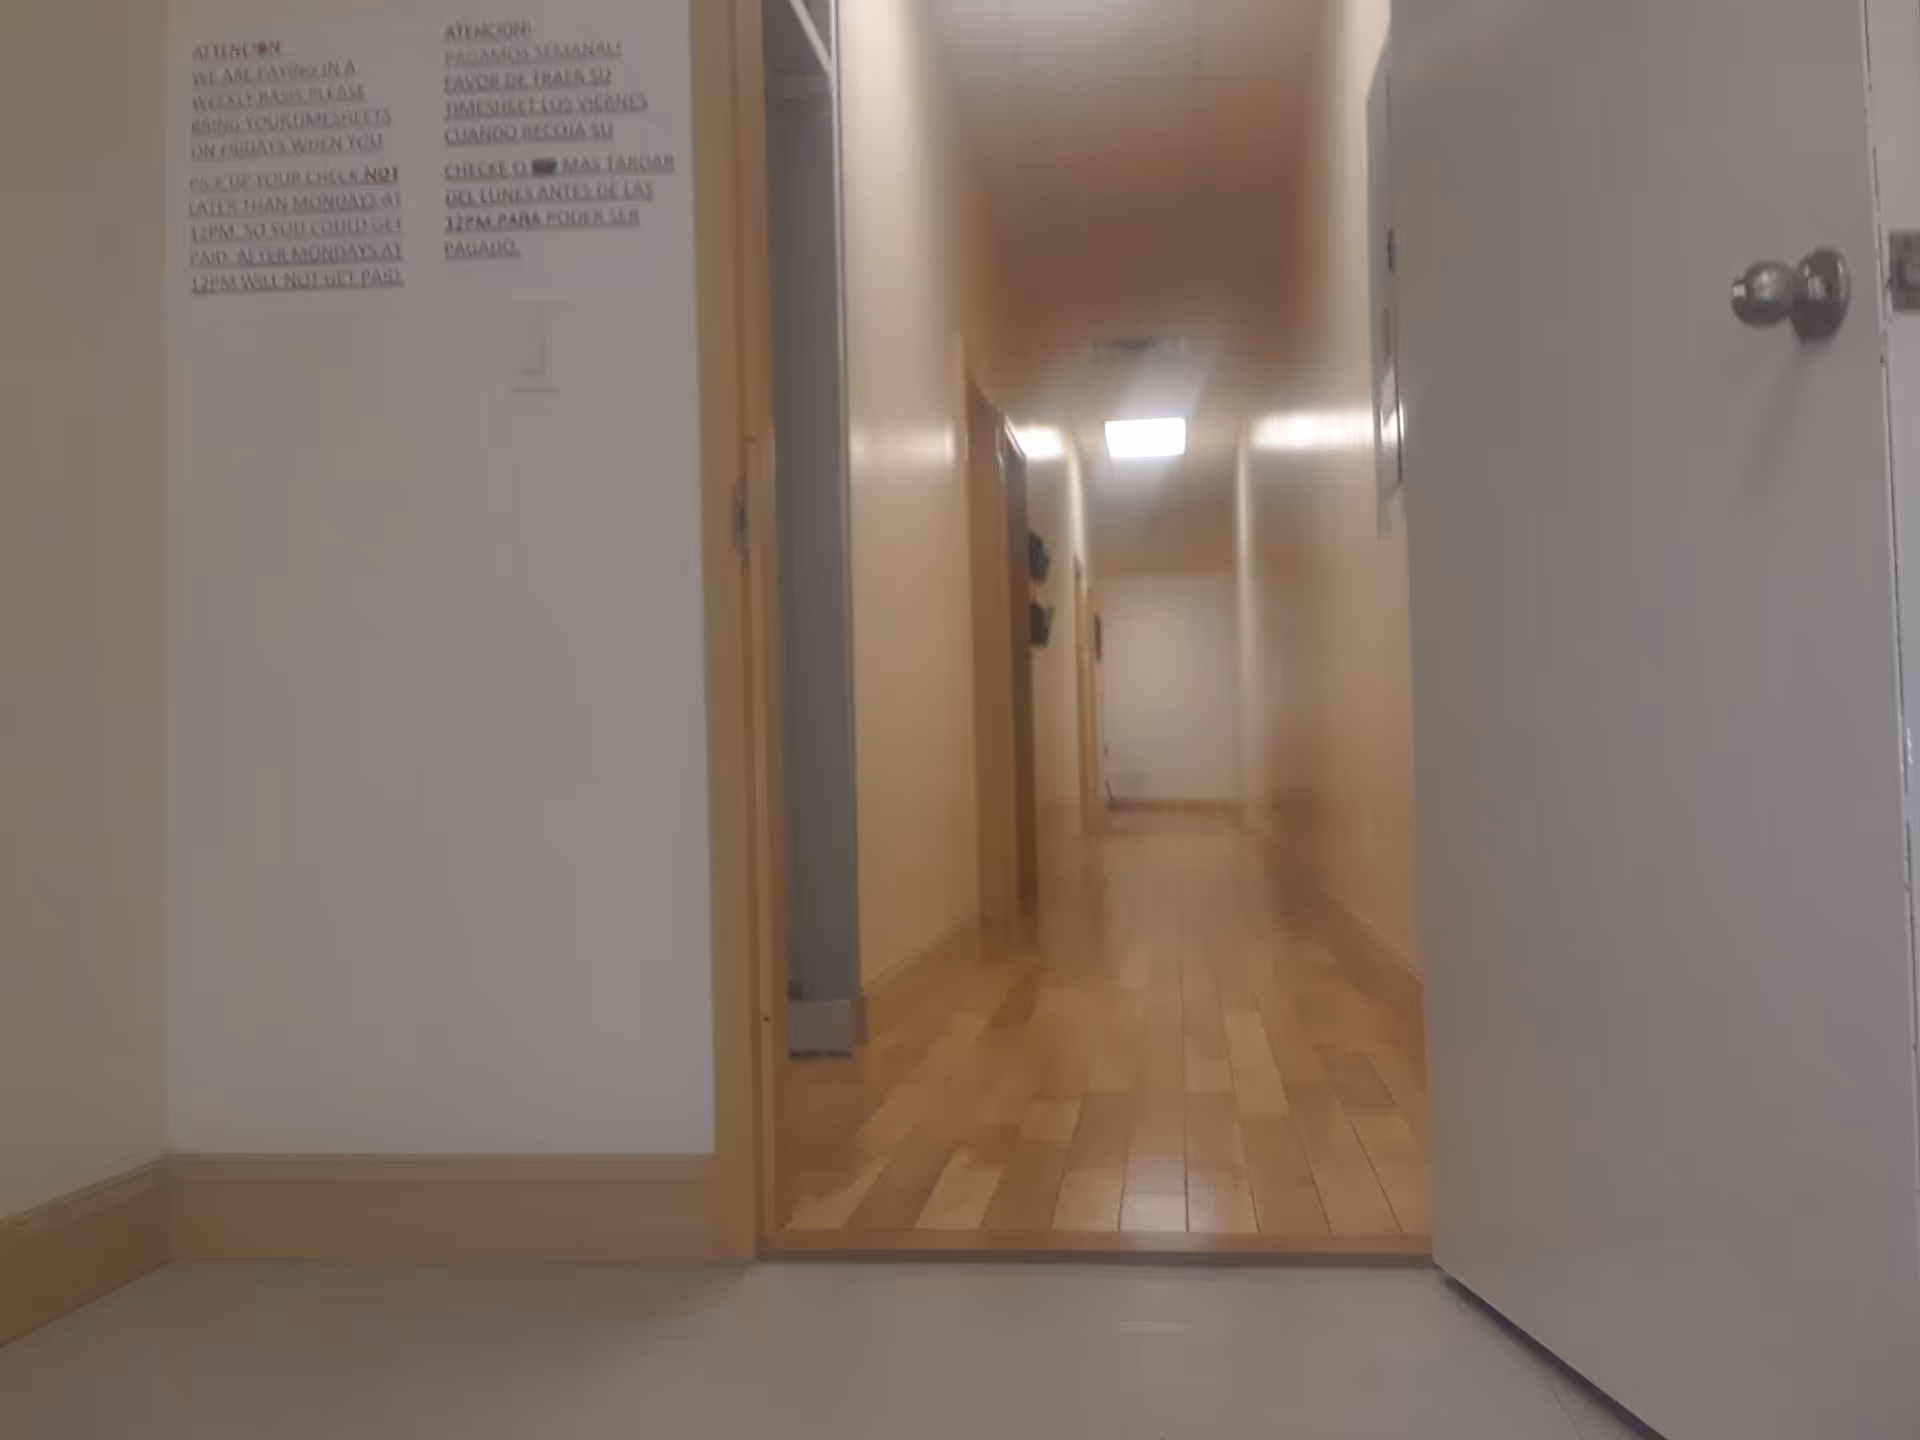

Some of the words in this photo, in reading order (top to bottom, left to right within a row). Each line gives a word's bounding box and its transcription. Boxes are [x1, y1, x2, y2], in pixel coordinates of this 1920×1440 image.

[445, 48, 529, 68] PAGAMOS
[192, 69, 213, 88] WE
[223, 67, 250, 83] ARE
[258, 64, 319, 83] PAYING
[322, 60, 341, 81] IN
[344, 59, 356, 79] A
[444, 71, 499, 93] FAVOR
[504, 71, 528, 91] DE
[534, 68, 583, 88] TRAER
[585, 66, 612, 87] SU
[192, 92, 251, 111] WEEKLY
[445, 97, 533, 119] TIMESHEET
[541, 96, 572, 115] LOS
[576, 91, 649, 114] VIERNES
[191, 116, 241, 135] BRING
[445, 125, 518, 145] CUANDO
[522, 122, 586, 142] RECOJA
[590, 120, 614, 139] SU
[192, 144, 215, 161] ON
[219, 139, 286, 160] FRIDAYS
[290, 136, 342, 157] WHEN
[346, 132, 384, 154] YOU
[562, 156, 601, 175] MAS
[607, 153, 675, 173] TARDAR
[190, 175, 222, 193] PICK
[228, 174, 250, 193] UP
[257, 170, 301, 191] YOUR
[364, 165, 400, 186] NOT
[189, 199, 237, 218] LATER
[243, 195, 288, 216] THAN
[293, 191, 377, 215] MONDAYS
[381, 190, 401, 209] AT
[446, 190, 473, 208] DEL
[480, 186, 534, 206] LUNES
[538, 183, 593, 203] ANTES
[596, 181, 620, 200] DE
[623, 180, 654, 200] LAS
[244, 222, 266, 240] SO
[270, 220, 306, 239] YOU
[309, 218, 369, 238] COULD
[372, 215, 401, 235] GET
[498, 209, 541, 230] PARA
[546, 208, 604, 228] PODER
[609, 207, 641, 226] SER
[238, 246, 288, 267] AFTER
[290, 242, 378, 265] MONDAYS
[381, 240, 403, 263] AT
[192, 276, 237, 296] 12PM
[241, 272, 281, 291] WILL
[284, 271, 319, 290] NOT
[325, 270, 354, 289] GET
